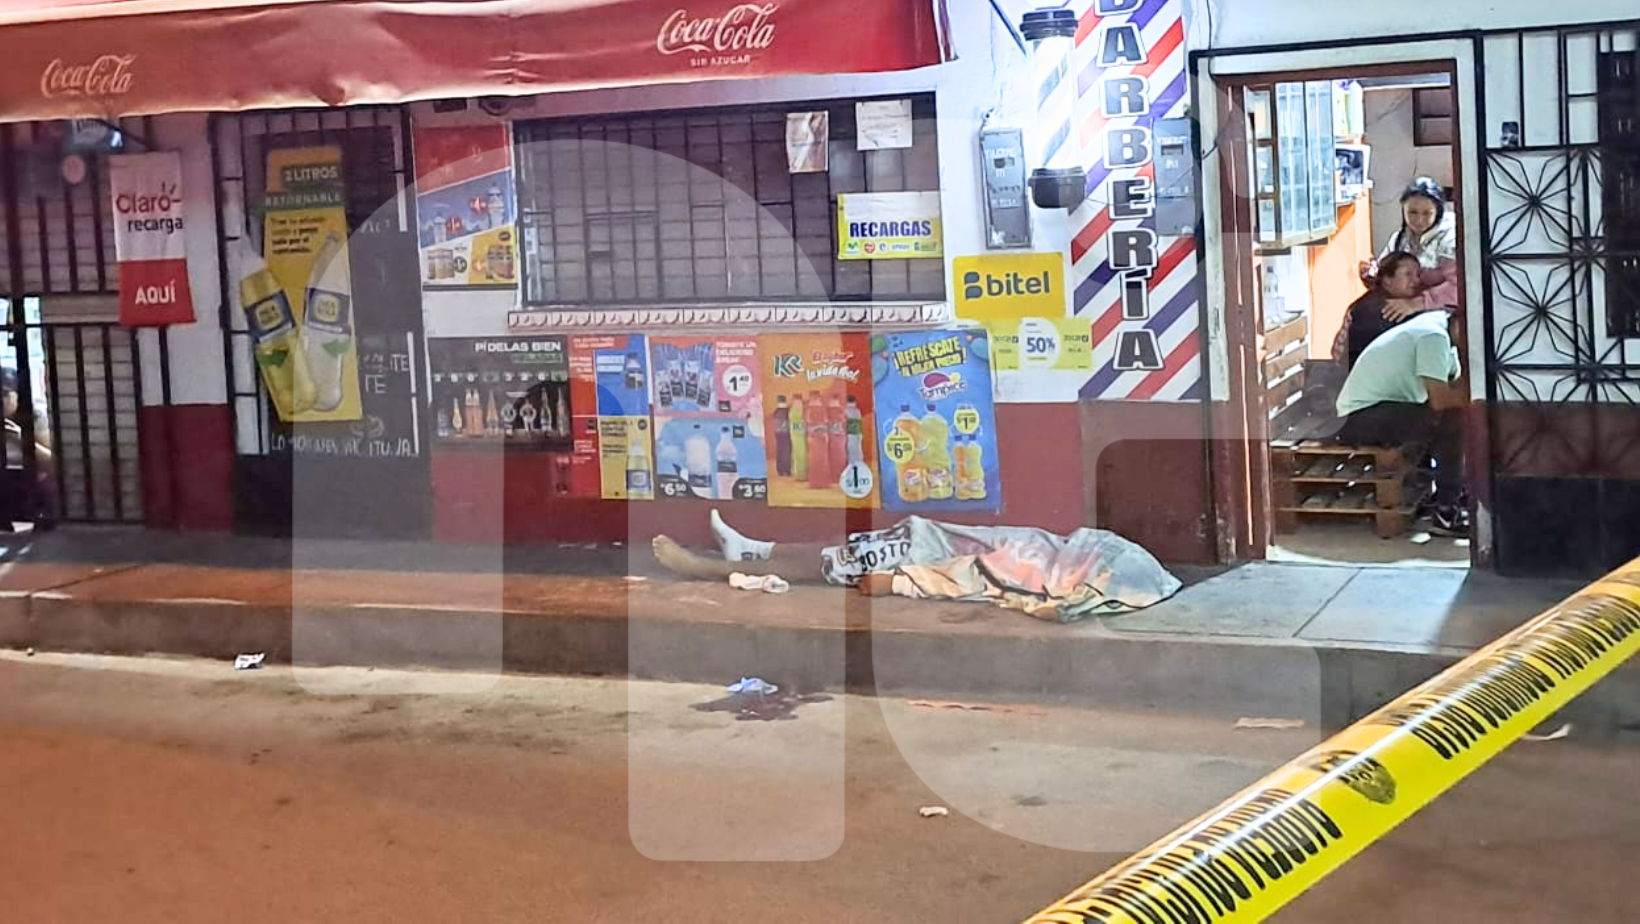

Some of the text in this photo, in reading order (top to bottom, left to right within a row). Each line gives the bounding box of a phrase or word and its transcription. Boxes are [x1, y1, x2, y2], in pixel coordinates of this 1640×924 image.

[293, 166, 339, 180] LITROS
[128, 217, 184, 235] recarga
[849, 220, 932, 238] RECARGAS
[986, 270, 1051, 297] bitel
[135, 280, 177, 306] AQUÍ
[531, 341, 562, 352] BIEN
[1026, 335, 1056, 353] 50%
